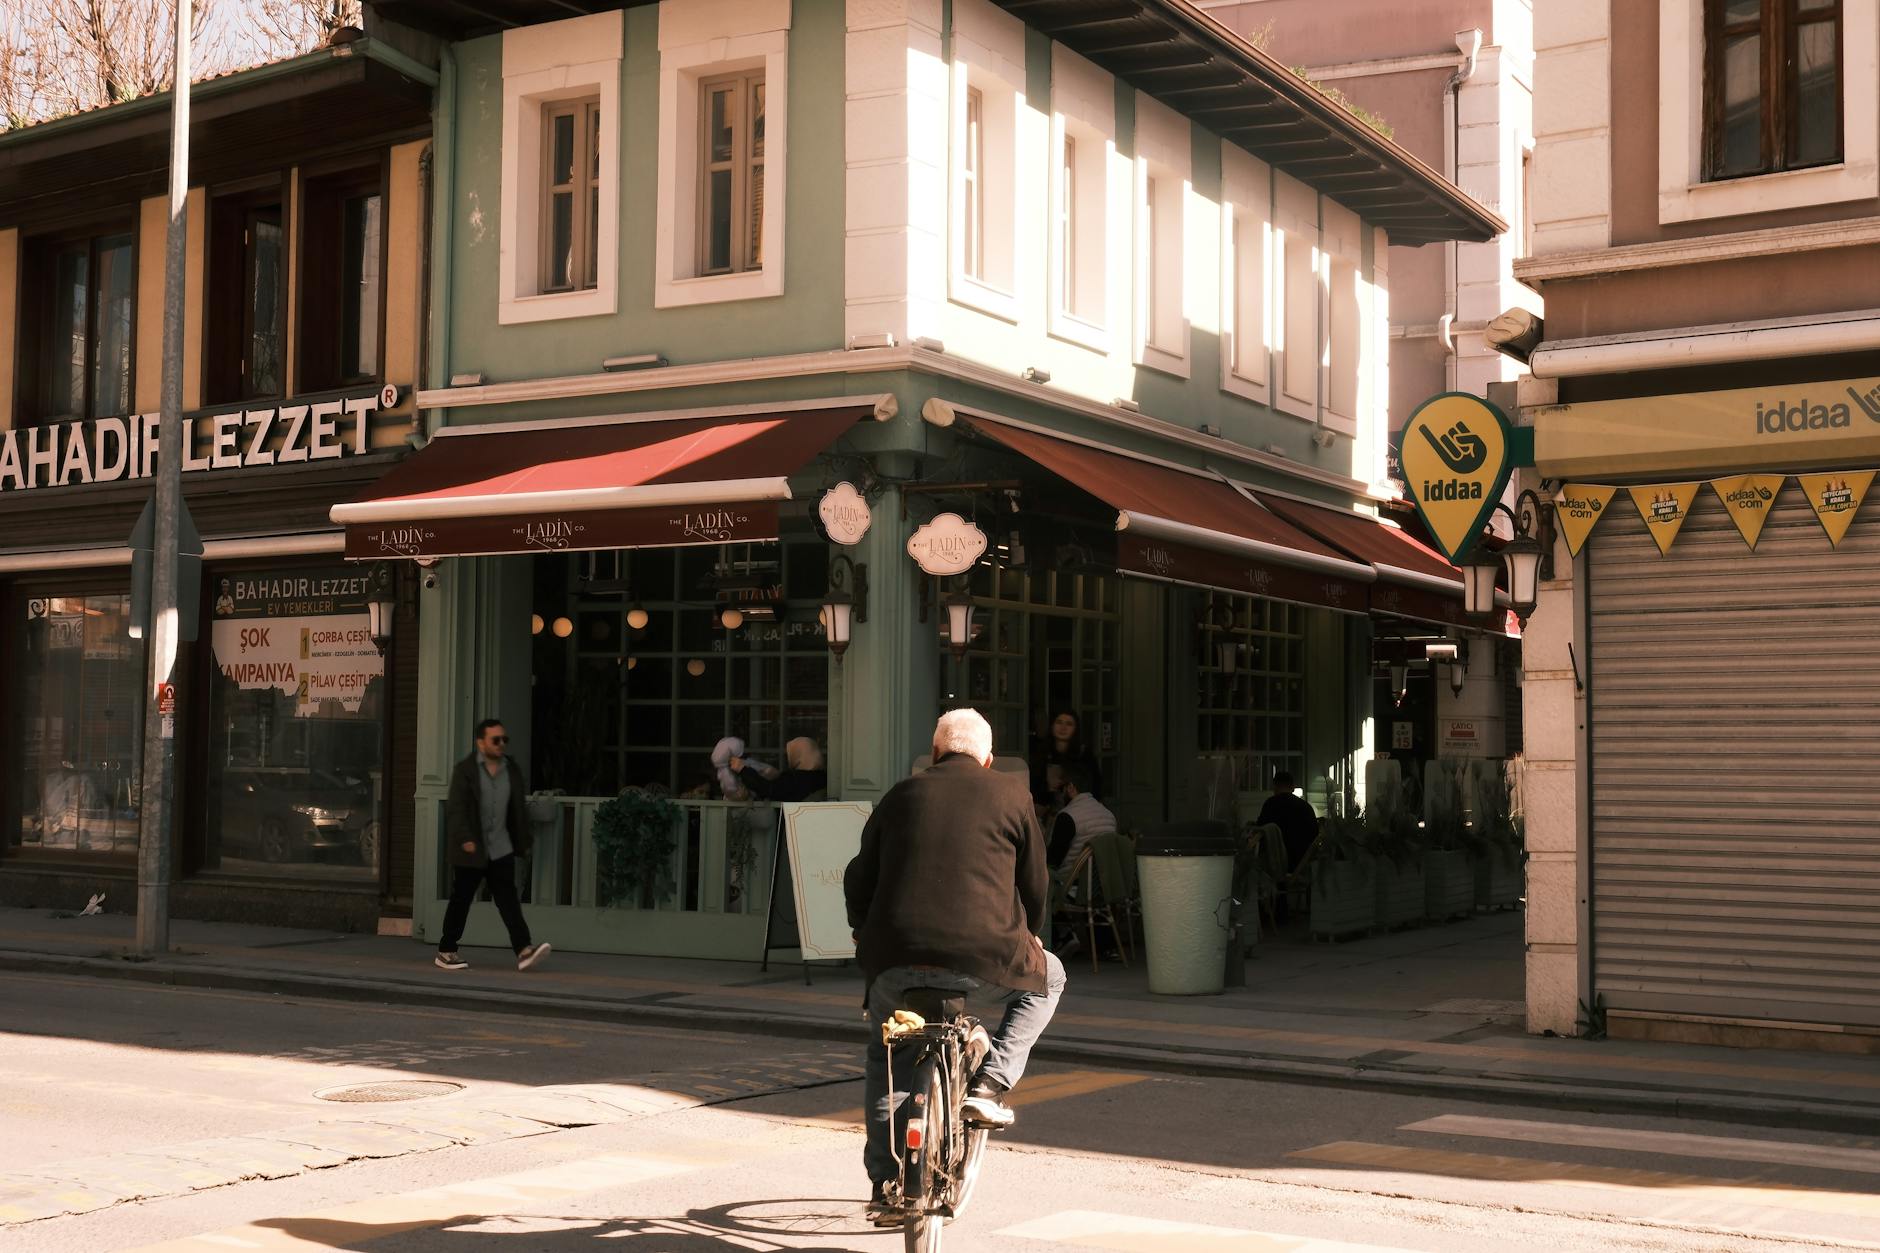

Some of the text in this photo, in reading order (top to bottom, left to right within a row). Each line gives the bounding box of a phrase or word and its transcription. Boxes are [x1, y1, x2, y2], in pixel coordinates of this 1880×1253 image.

[1757, 399, 1850, 434] iddaa
[182, 395, 378, 472] LEZZET
[1424, 480, 1482, 501] iddaa
[1726, 490, 1755, 502] iddaa
[1570, 509, 1592, 518] com
[1739, 500, 1762, 509] com
[527, 518, 573, 537] LADİN
[685, 509, 735, 529] LADİN
[381, 525, 423, 545] LADİN
[929, 534, 967, 551] LADİN
[236, 578, 368, 600] BAHADIR LEZZET
[268, 599, 334, 615] EV YEMEKLERİ
[240, 627, 271, 654] ŞOK
[303, 635, 308, 652] 1
[312, 631, 344, 646] ÇORBA
[301, 680, 308, 697] 2
[311, 670, 337, 688] PİLAV
